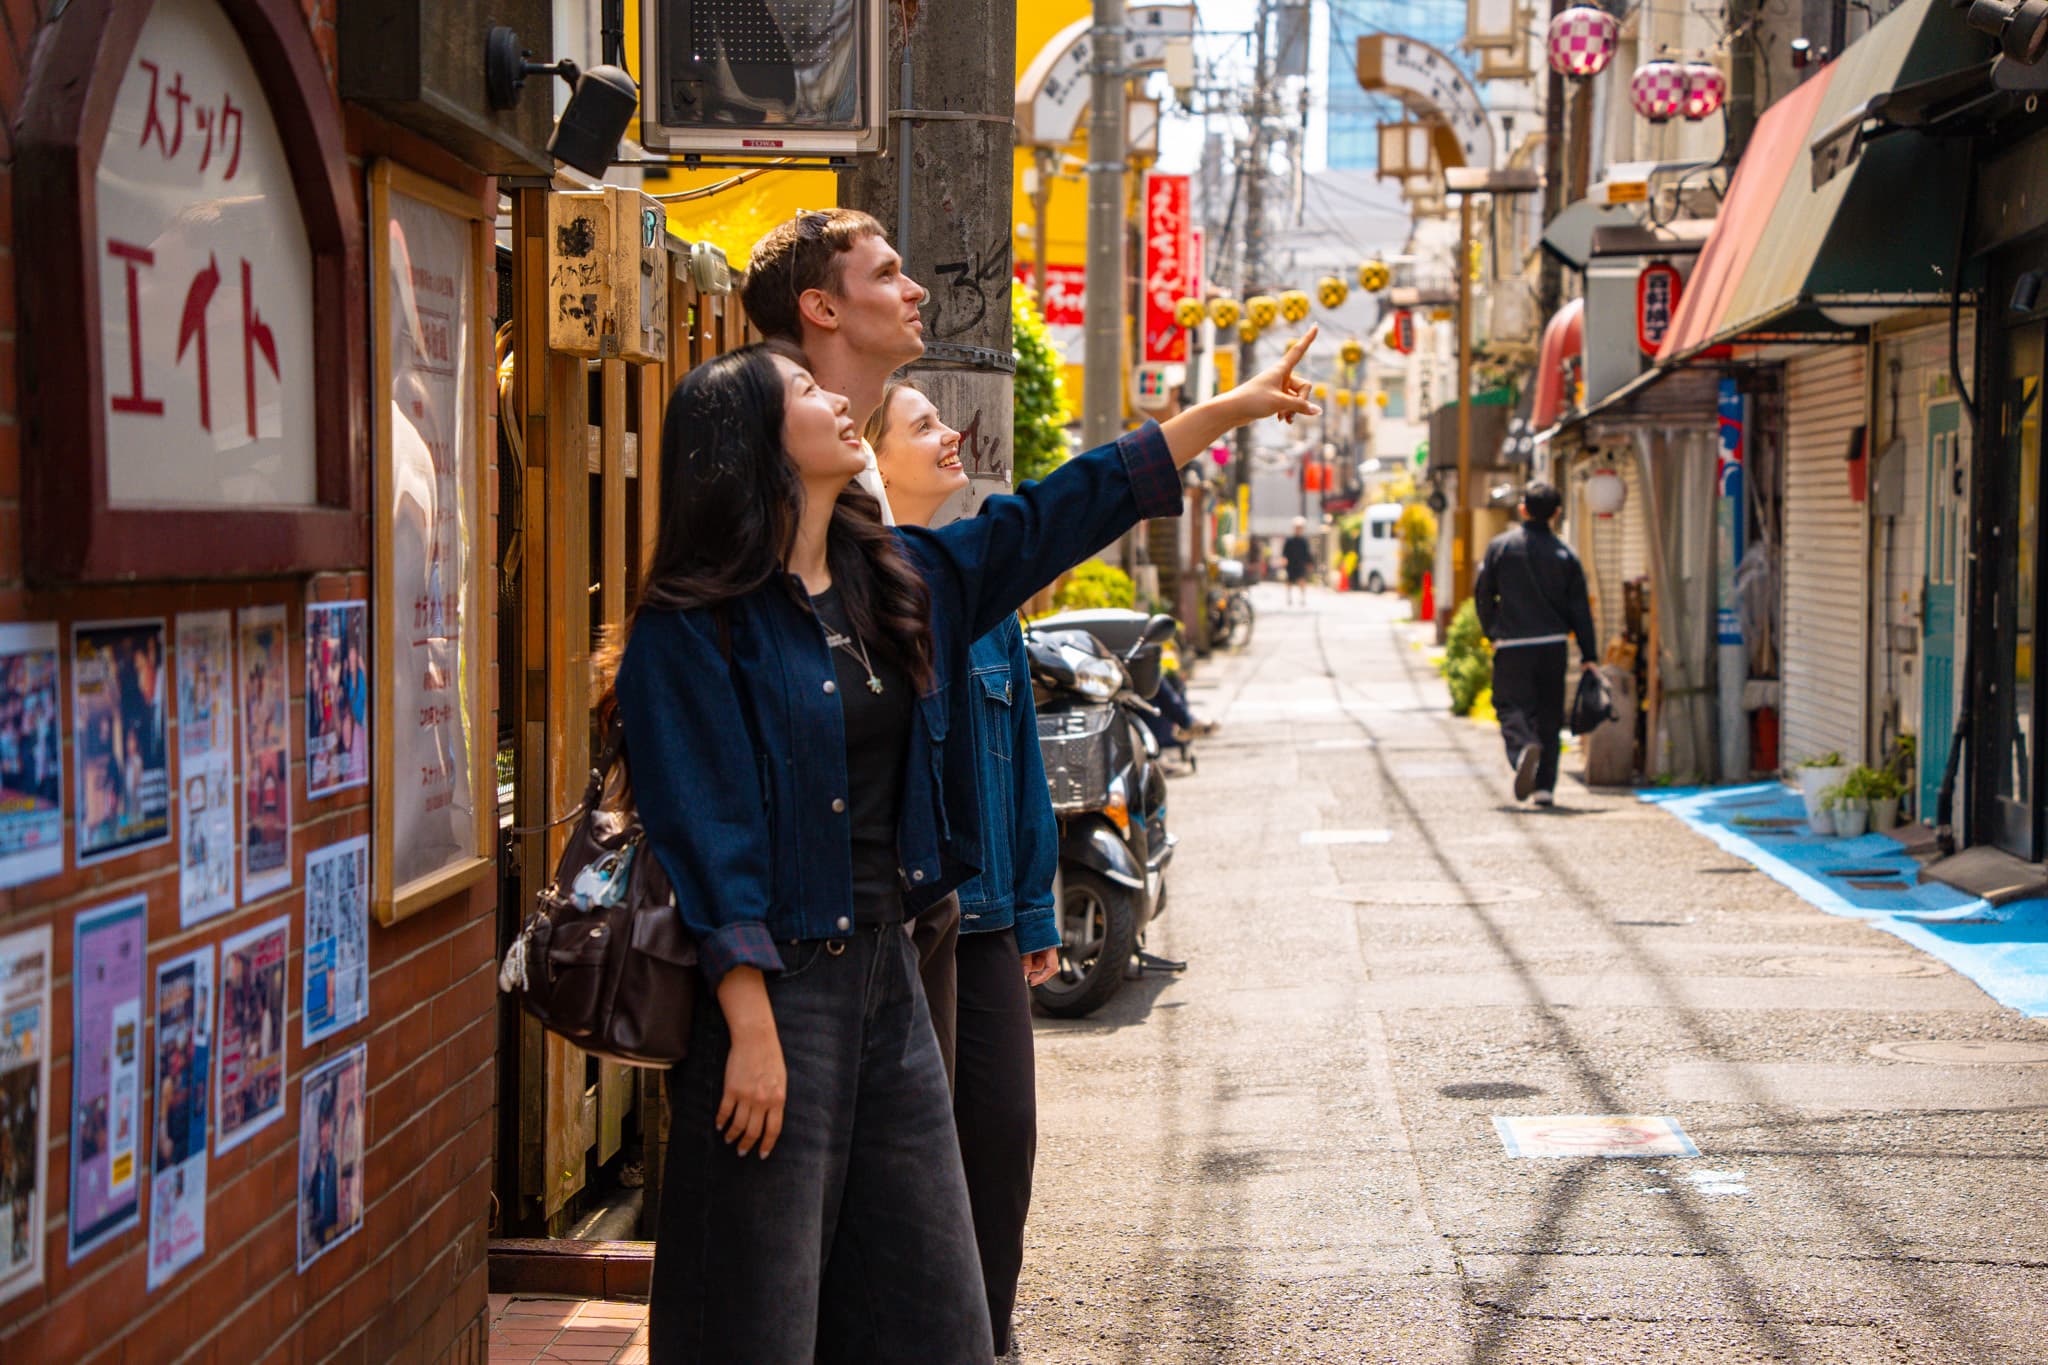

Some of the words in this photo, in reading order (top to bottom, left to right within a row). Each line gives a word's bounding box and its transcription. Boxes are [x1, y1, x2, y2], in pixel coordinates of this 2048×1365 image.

[140, 59, 243, 181] スナック
[107, 239, 281, 440] エイト
